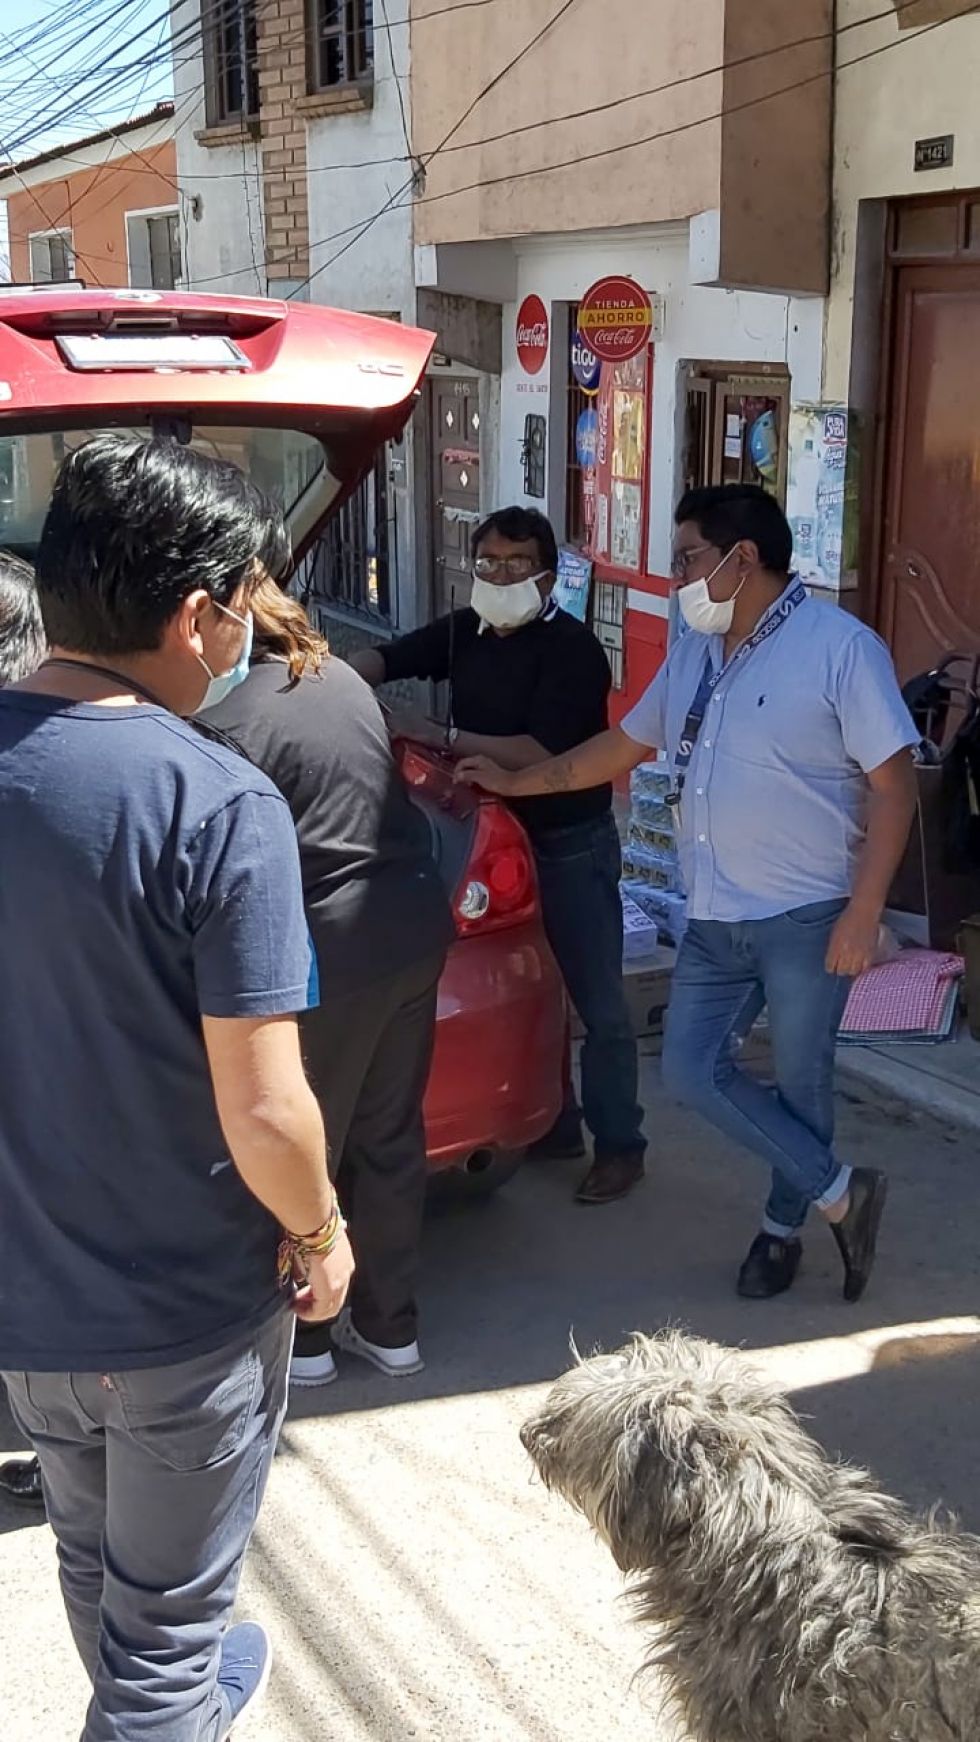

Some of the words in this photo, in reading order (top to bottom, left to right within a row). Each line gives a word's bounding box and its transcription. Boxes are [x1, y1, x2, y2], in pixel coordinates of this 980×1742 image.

[595, 300, 635, 308] TIENDA
[587, 311, 645, 325] AHORRO
[571, 346, 597, 366] tigo
